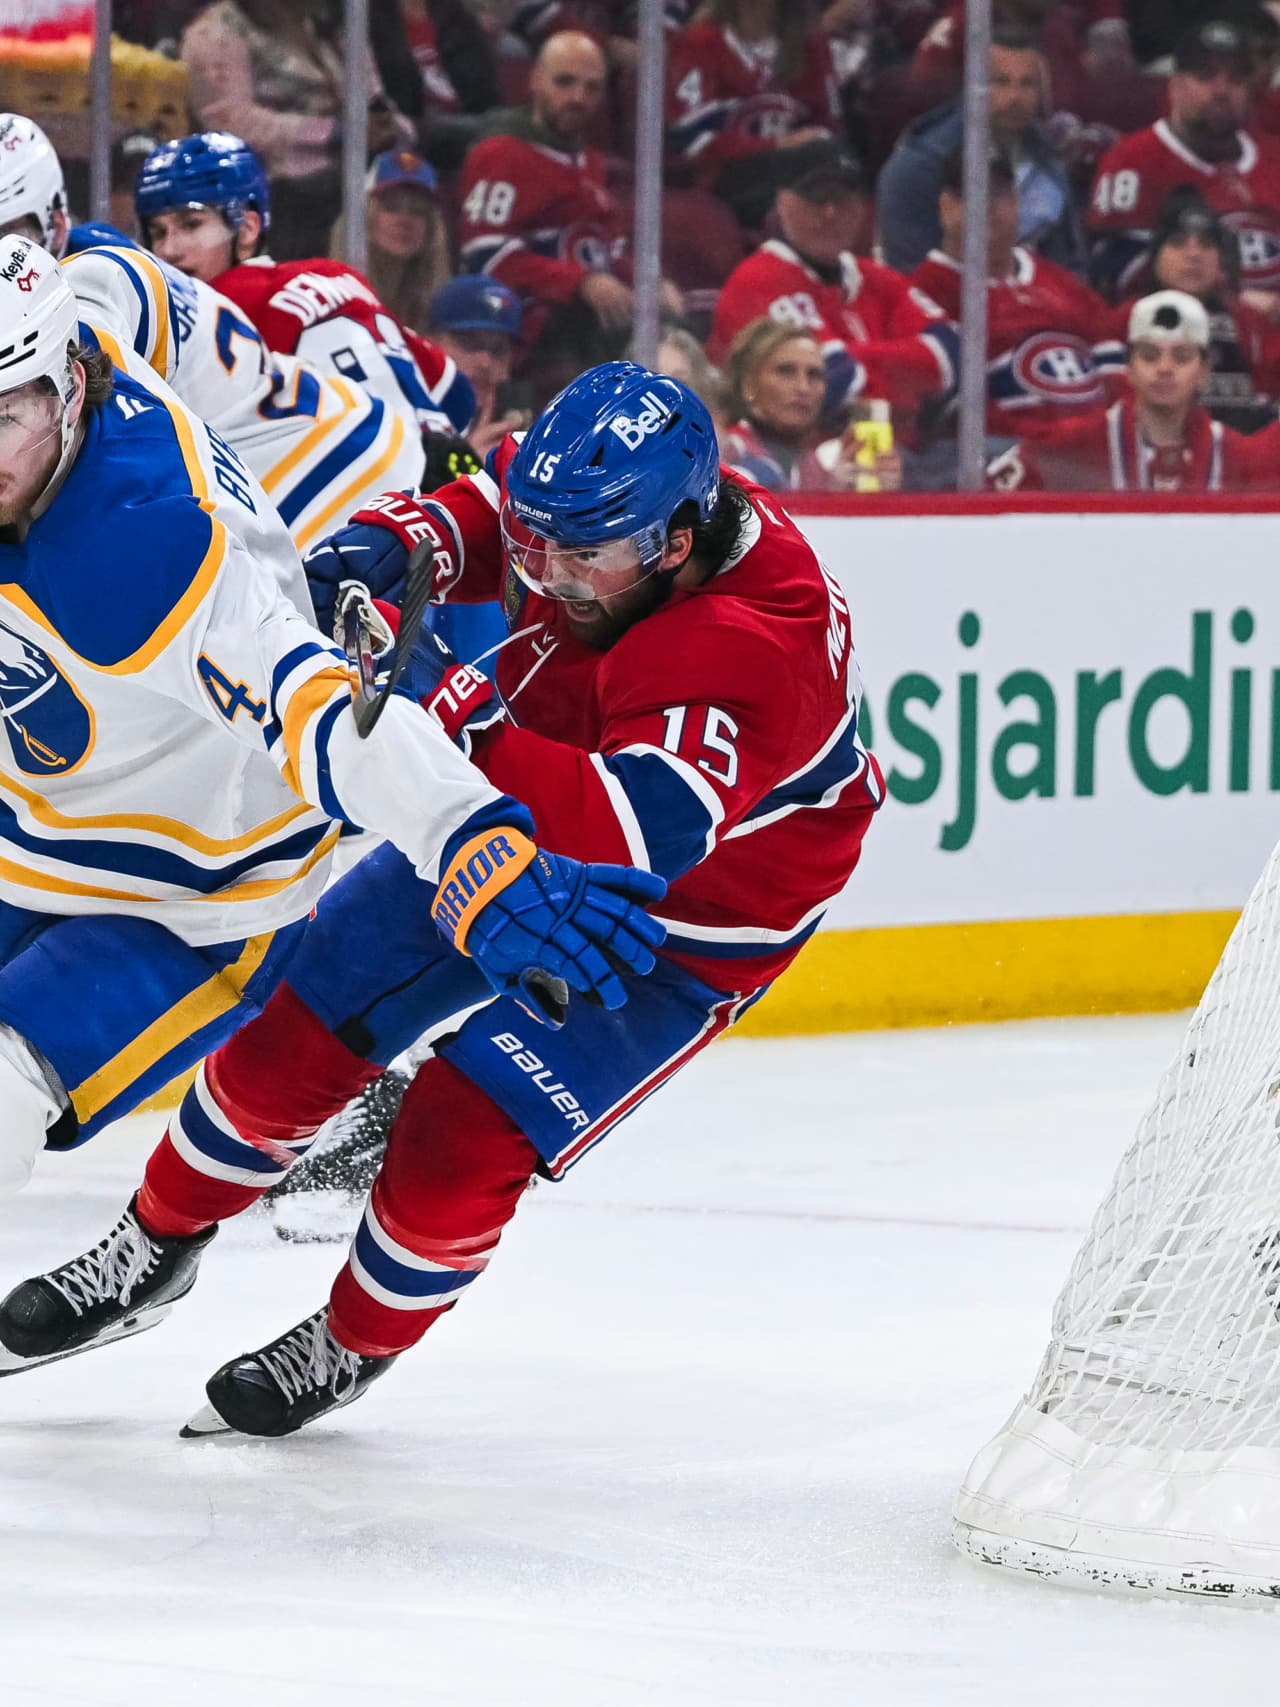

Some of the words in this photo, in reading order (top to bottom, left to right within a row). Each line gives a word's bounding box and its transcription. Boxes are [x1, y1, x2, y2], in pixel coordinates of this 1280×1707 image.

[464, 179, 516, 225] 48
[609, 391, 671, 451] Bell
[529, 451, 560, 484] 15
[196, 651, 267, 724] 4
[663, 705, 740, 788] 15
[856, 608, 1280, 851] sjardi
[490, 1031, 590, 1131] BAUER
